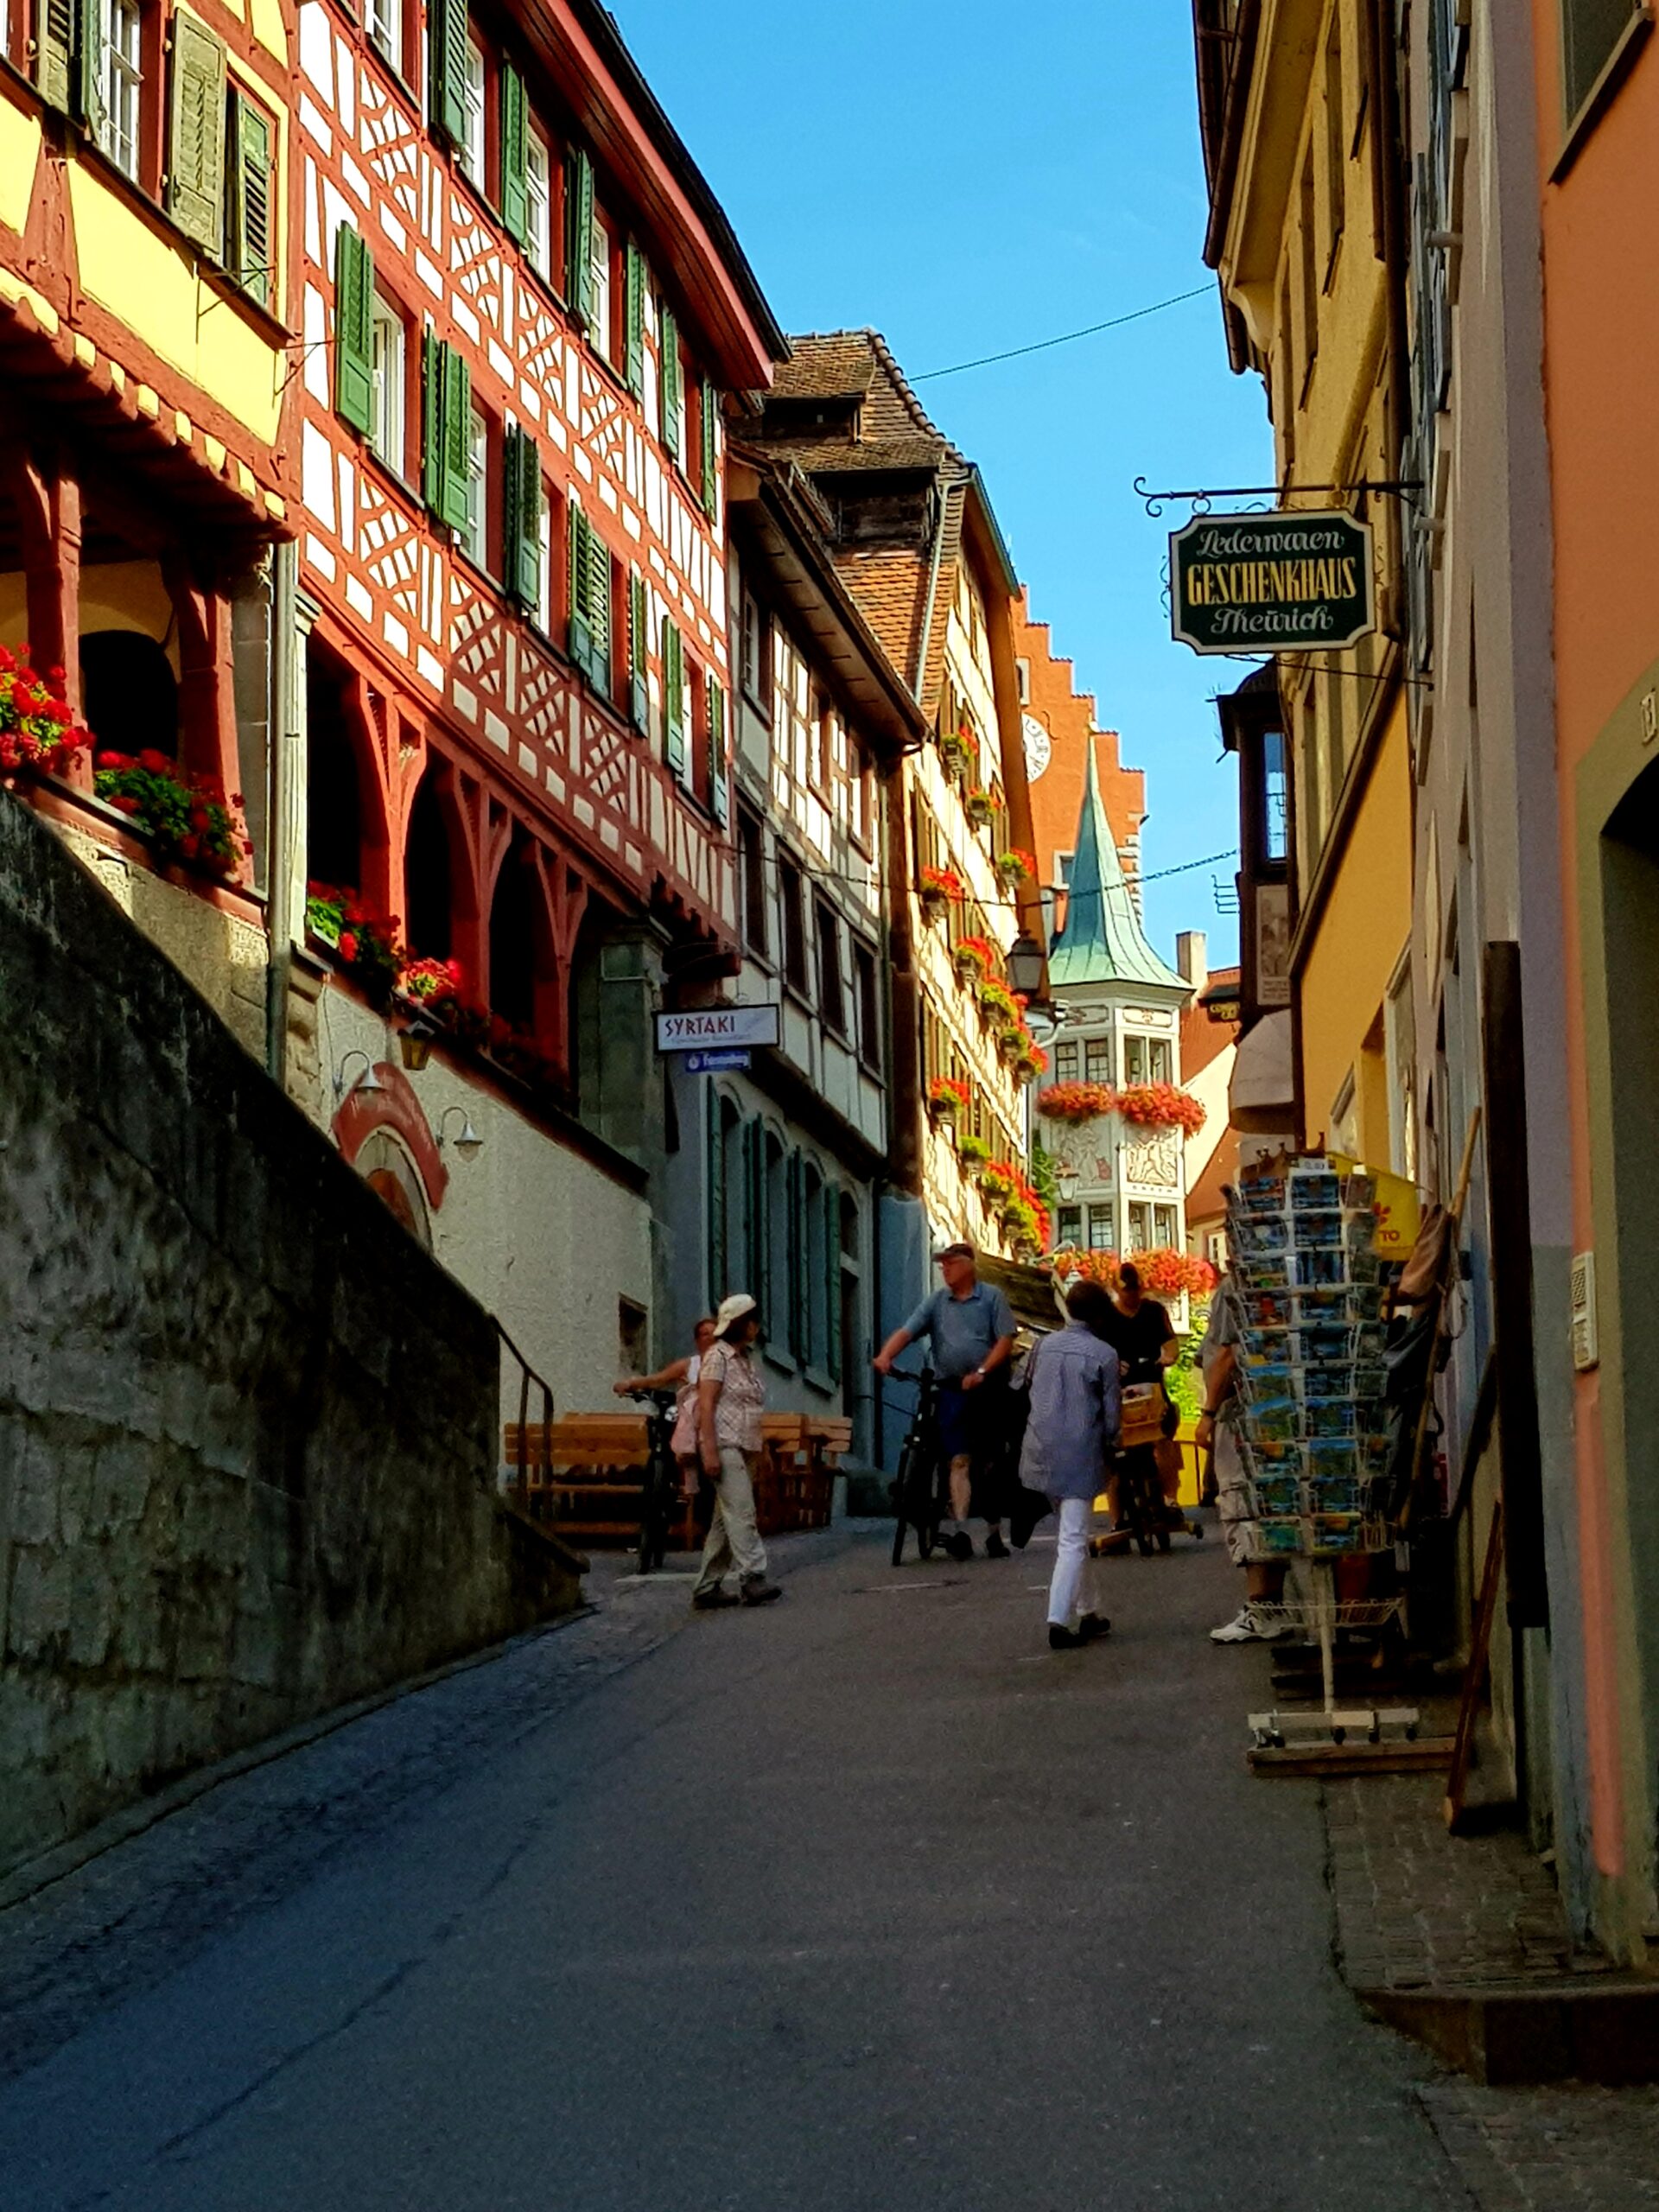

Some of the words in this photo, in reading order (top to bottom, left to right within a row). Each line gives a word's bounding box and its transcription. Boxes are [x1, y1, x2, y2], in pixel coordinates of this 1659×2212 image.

[1196, 528, 1344, 559] Lederwaren
[1187, 556, 1357, 606] GESCHENKHAUS
[664, 1014, 734, 1037] SYRTAKI
